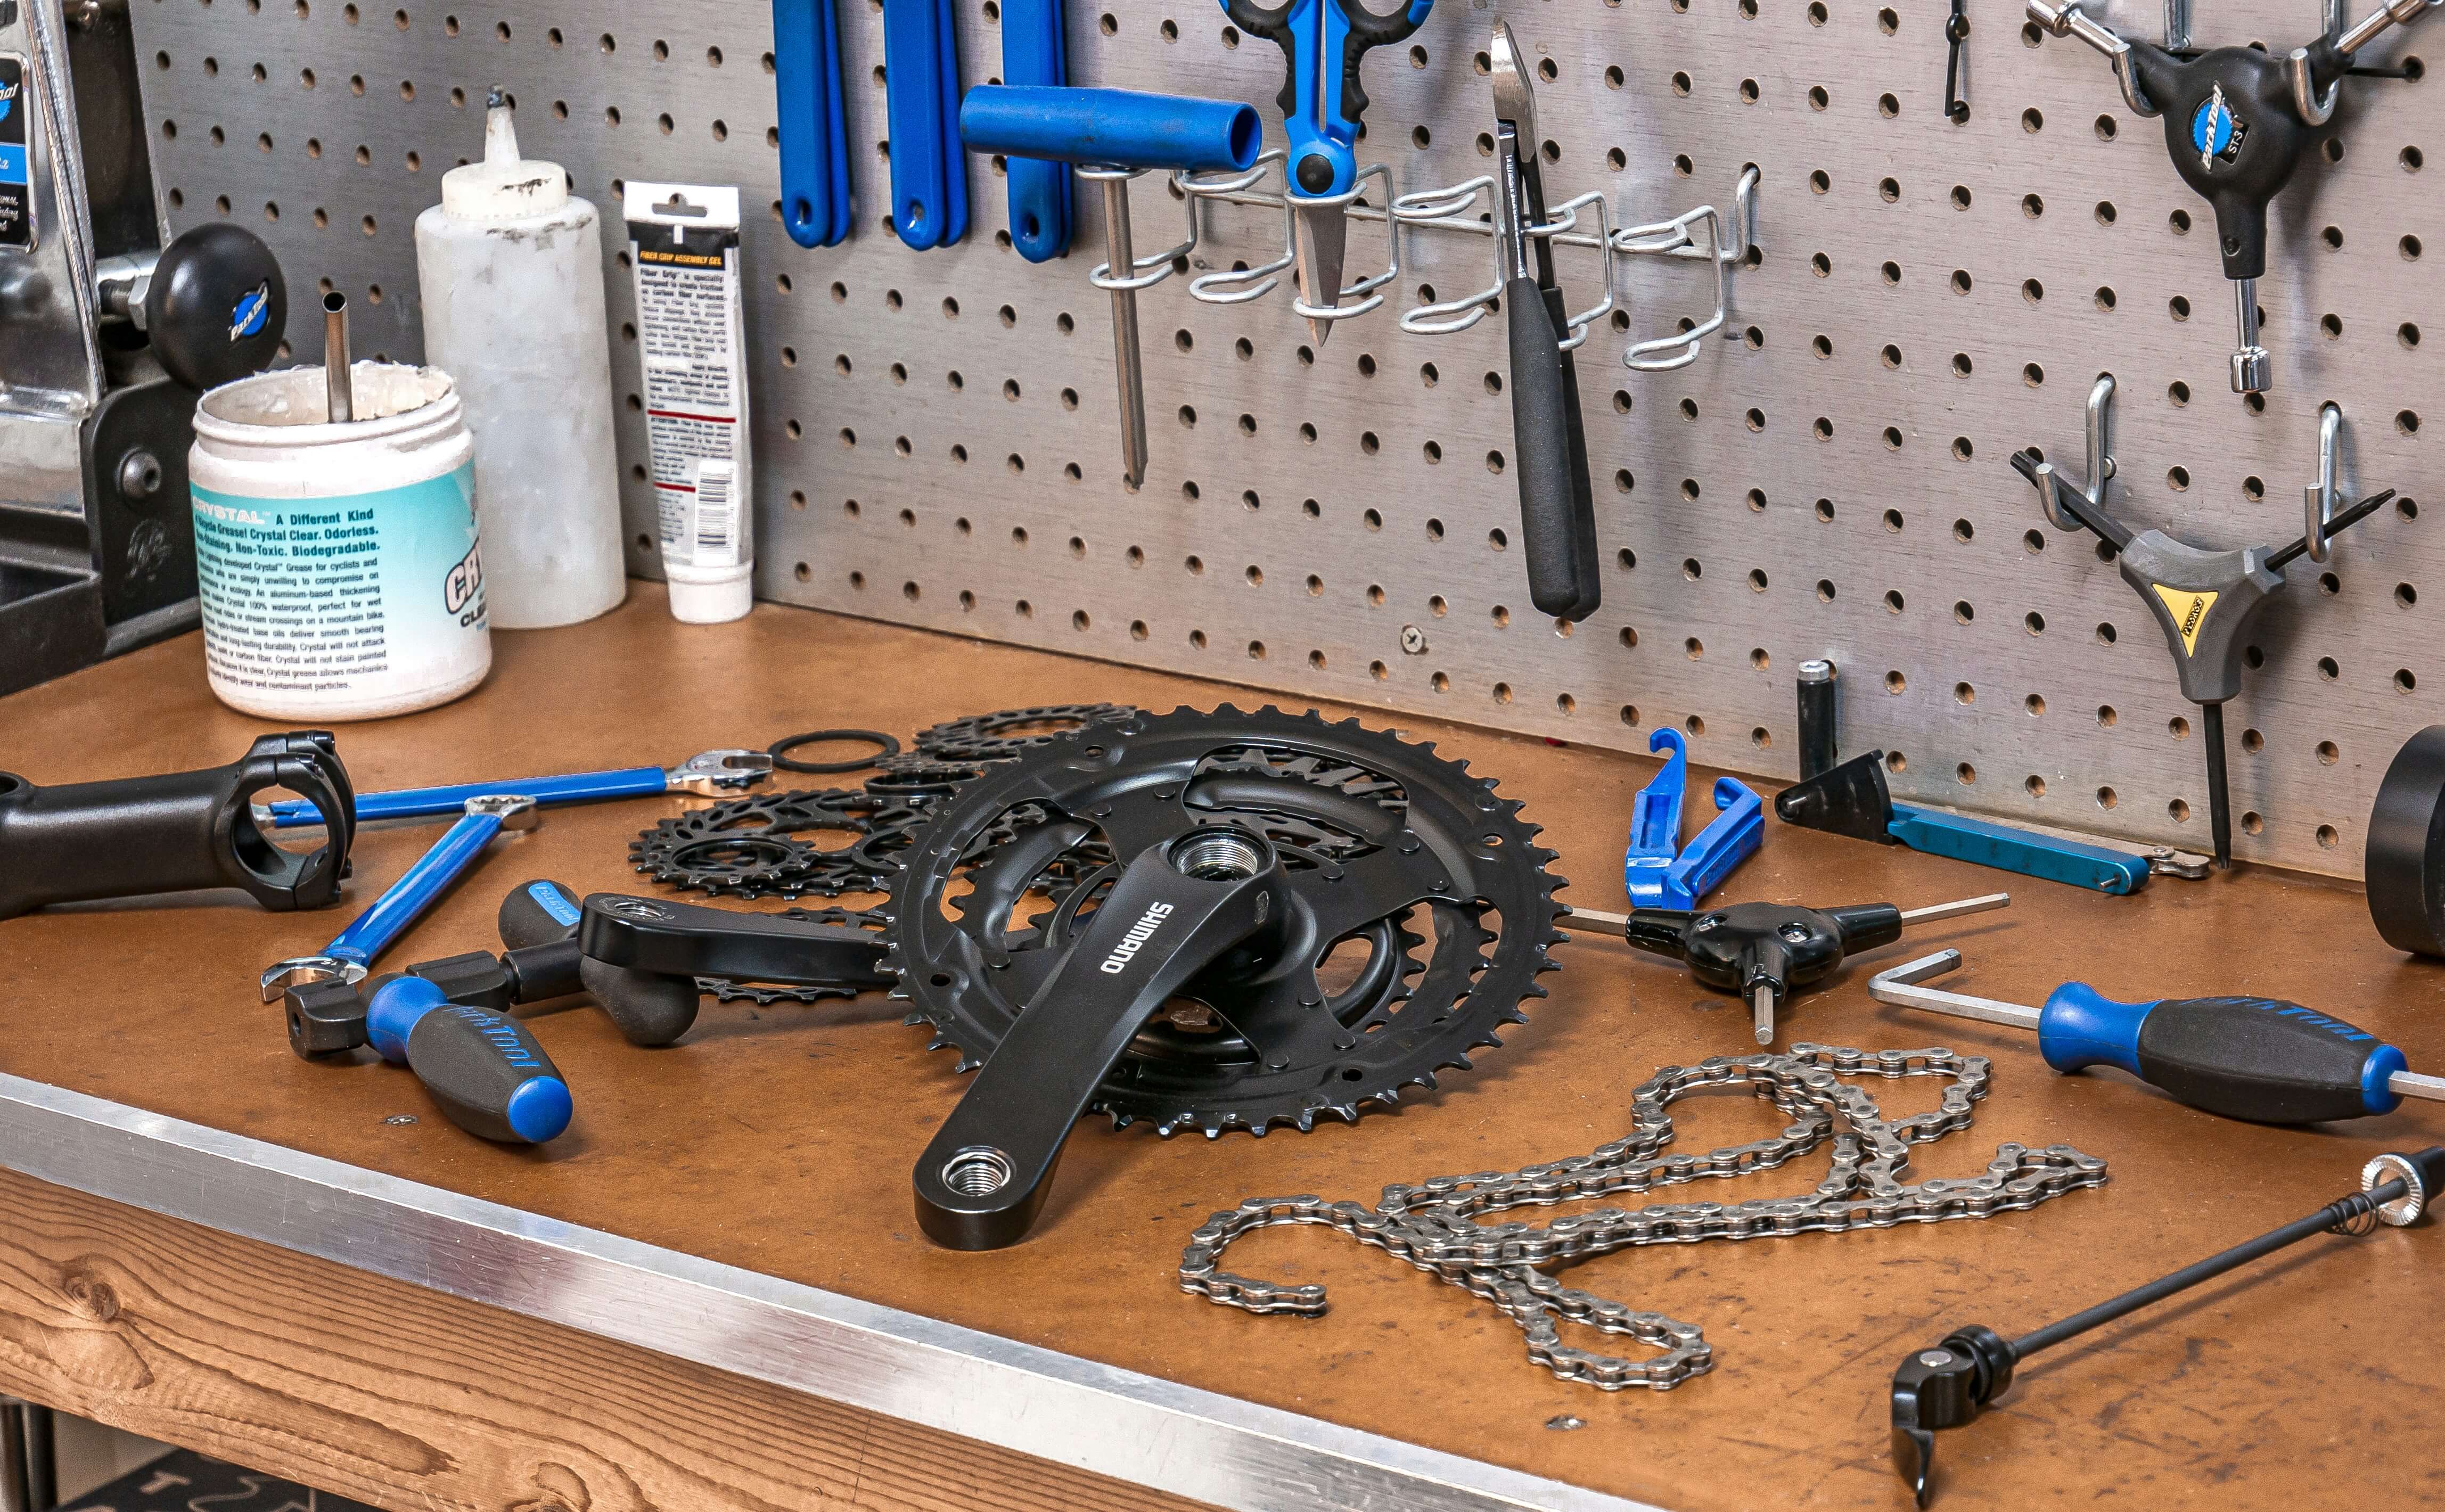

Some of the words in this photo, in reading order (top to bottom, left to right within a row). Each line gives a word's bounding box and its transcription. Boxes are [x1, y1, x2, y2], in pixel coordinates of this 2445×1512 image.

[2228, 130, 2243, 154] ST-3
[639, 251, 658, 260] FIBER
[674, 254, 708, 264] ASSEMBLY
[276, 514, 283, 525] A
[290, 512, 341, 525] Different
[348, 507, 374, 522] Kind
[250, 528, 286, 543] Crystal
[290, 529, 322, 541] Clear.
[324, 525, 379, 540] Odorless.
[235, 541, 288, 557] Non-Toxic.
[292, 540, 381, 557] Biodegradable.
[286, 563, 313, 572] Grease
[316, 562, 327, 571] for
[330, 561, 360, 572] cyclists
[363, 557, 378, 567] and
[315, 573, 364, 585] compromise
[270, 589, 333, 598] aluminum-based
[340, 585, 381, 596] thickening
[249, 600, 267, 610] 100%
[318, 601, 346, 612] perfect
[351, 599, 362, 608] for
[367, 597, 381, 606] wet
[268, 616, 303, 627] crossings
[327, 613, 364, 624] mountain
[290, 629, 315, 638] deliver
[320, 627, 350, 637] smooth
[354, 624, 384, 635] bearing
[300, 642, 326, 652] Crystal
[330, 640, 343, 650] will
[346, 639, 359, 648] not
[362, 637, 385, 647] attack
[275, 654, 300, 665] Crystal
[304, 655, 317, 664] will
[319, 655, 332, 664] not
[335, 654, 355, 663] stain
[358, 649, 387, 663] painted
[267, 667, 291, 679] Crystal
[293, 669, 317, 680] grease
[319, 668, 345, 677] allows
[346, 663, 388, 676] mechanics
[1100, 901, 1174, 974] SHIMANO
